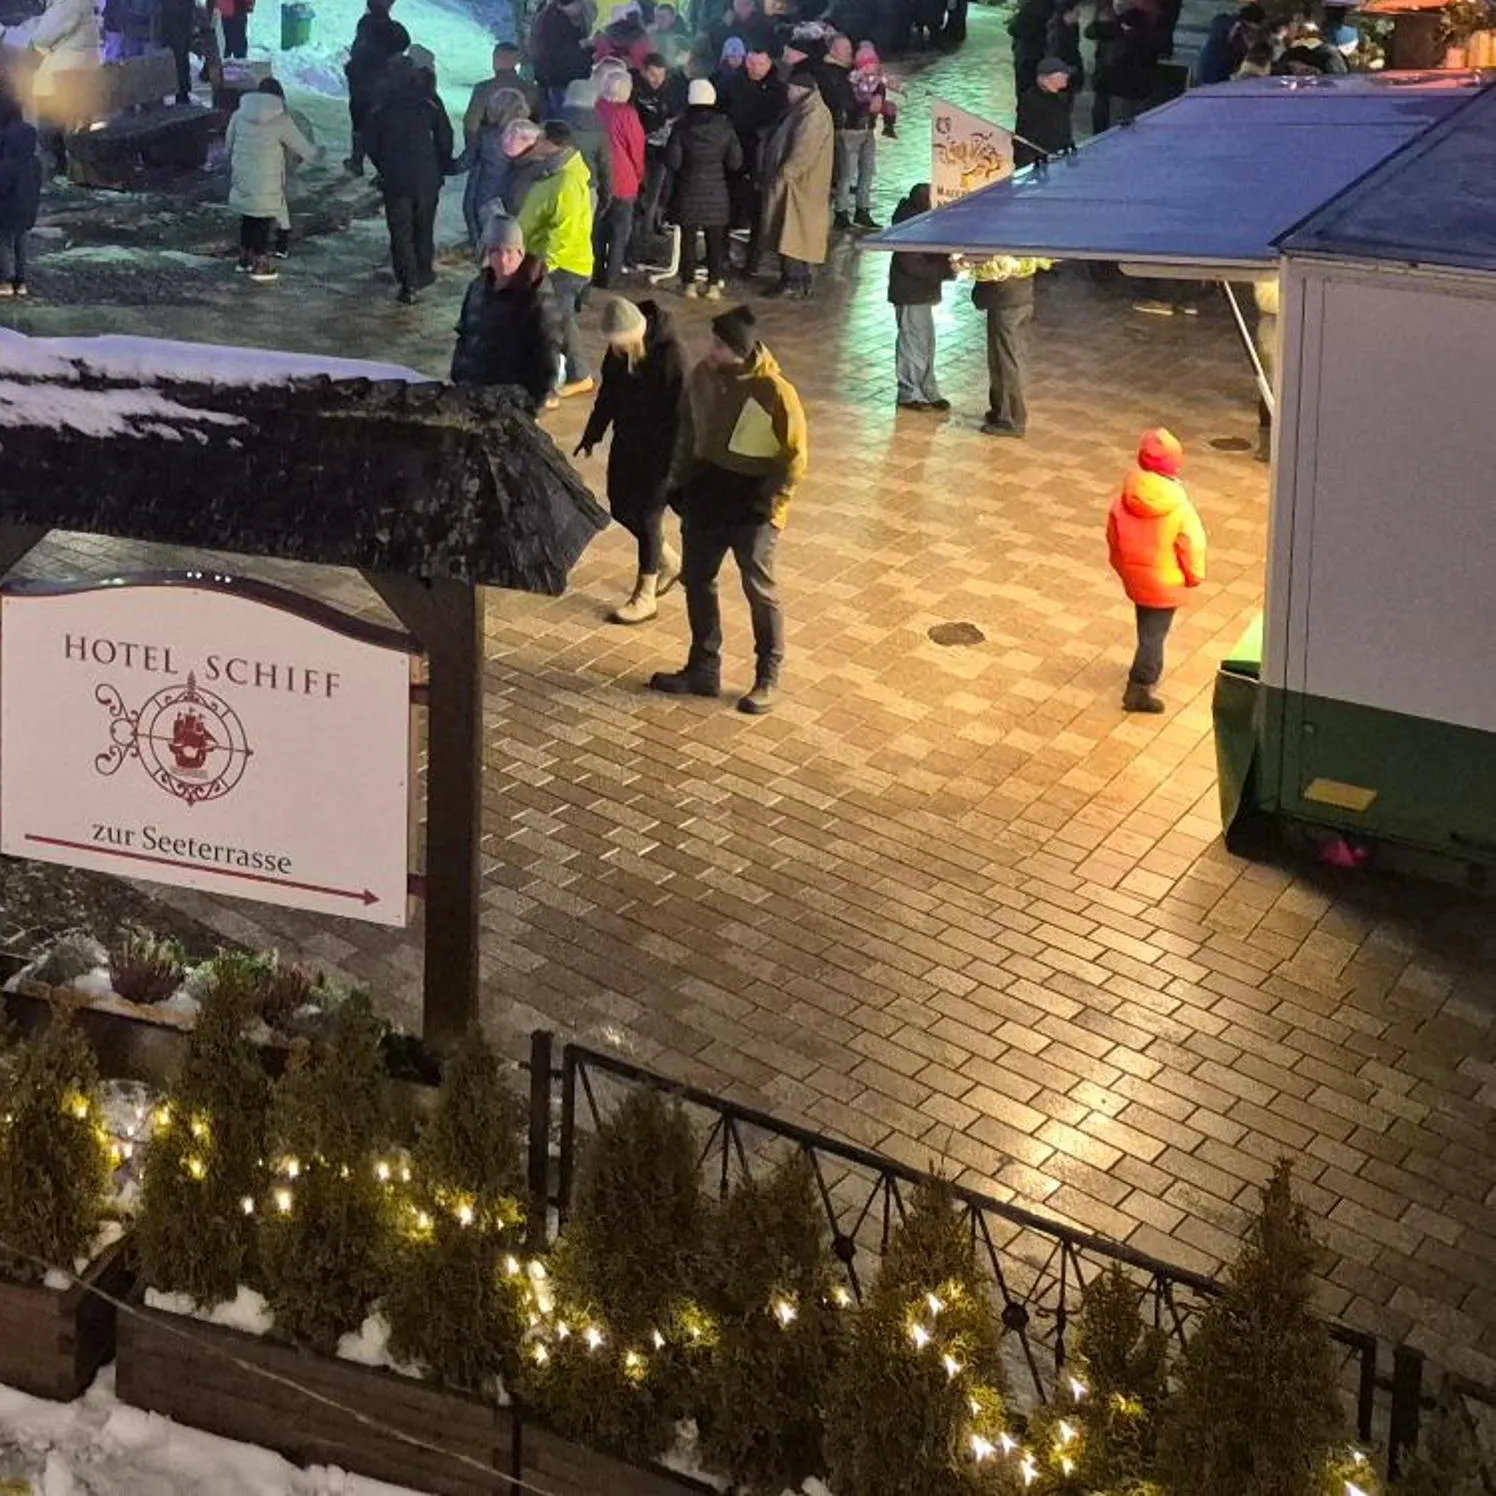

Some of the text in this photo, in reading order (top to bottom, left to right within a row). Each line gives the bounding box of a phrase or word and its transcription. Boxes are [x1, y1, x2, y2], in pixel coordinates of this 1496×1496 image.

[64, 633, 341, 698] HOTEL SCHIFF
[92, 823, 292, 875] zur Seeterrasse
